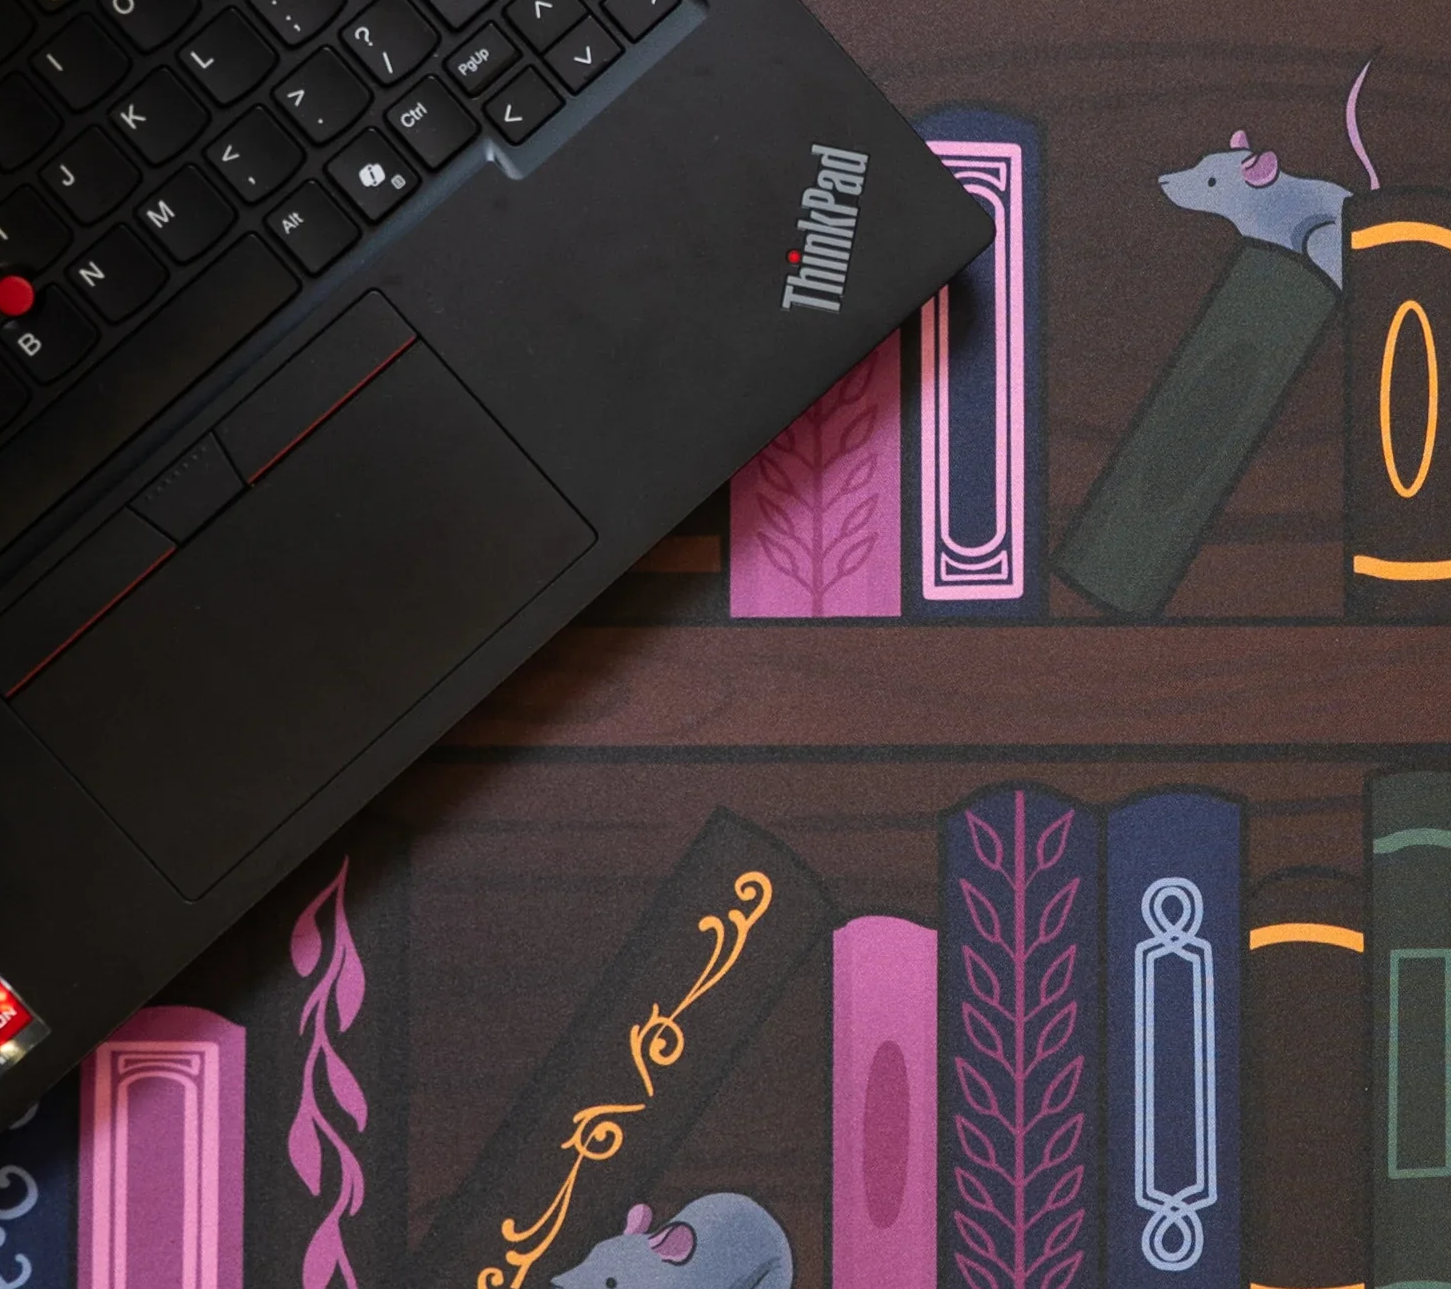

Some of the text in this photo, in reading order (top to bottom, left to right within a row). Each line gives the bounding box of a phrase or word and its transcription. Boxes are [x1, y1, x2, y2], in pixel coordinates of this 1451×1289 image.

[45, 53, 64, 72] I
[189, 50, 215, 70] L
[457, 47, 490, 77] PgUp
[119, 103, 147, 130] K
[399, 101, 428, 129] Ctrl
[59, 164, 76, 187] J
[145, 199, 176, 229] M
[281, 211, 304, 235] Alt
[782, 144, 869, 311] ThinkPad
[78, 260, 106, 288] N
[16, 331, 43, 357] B
